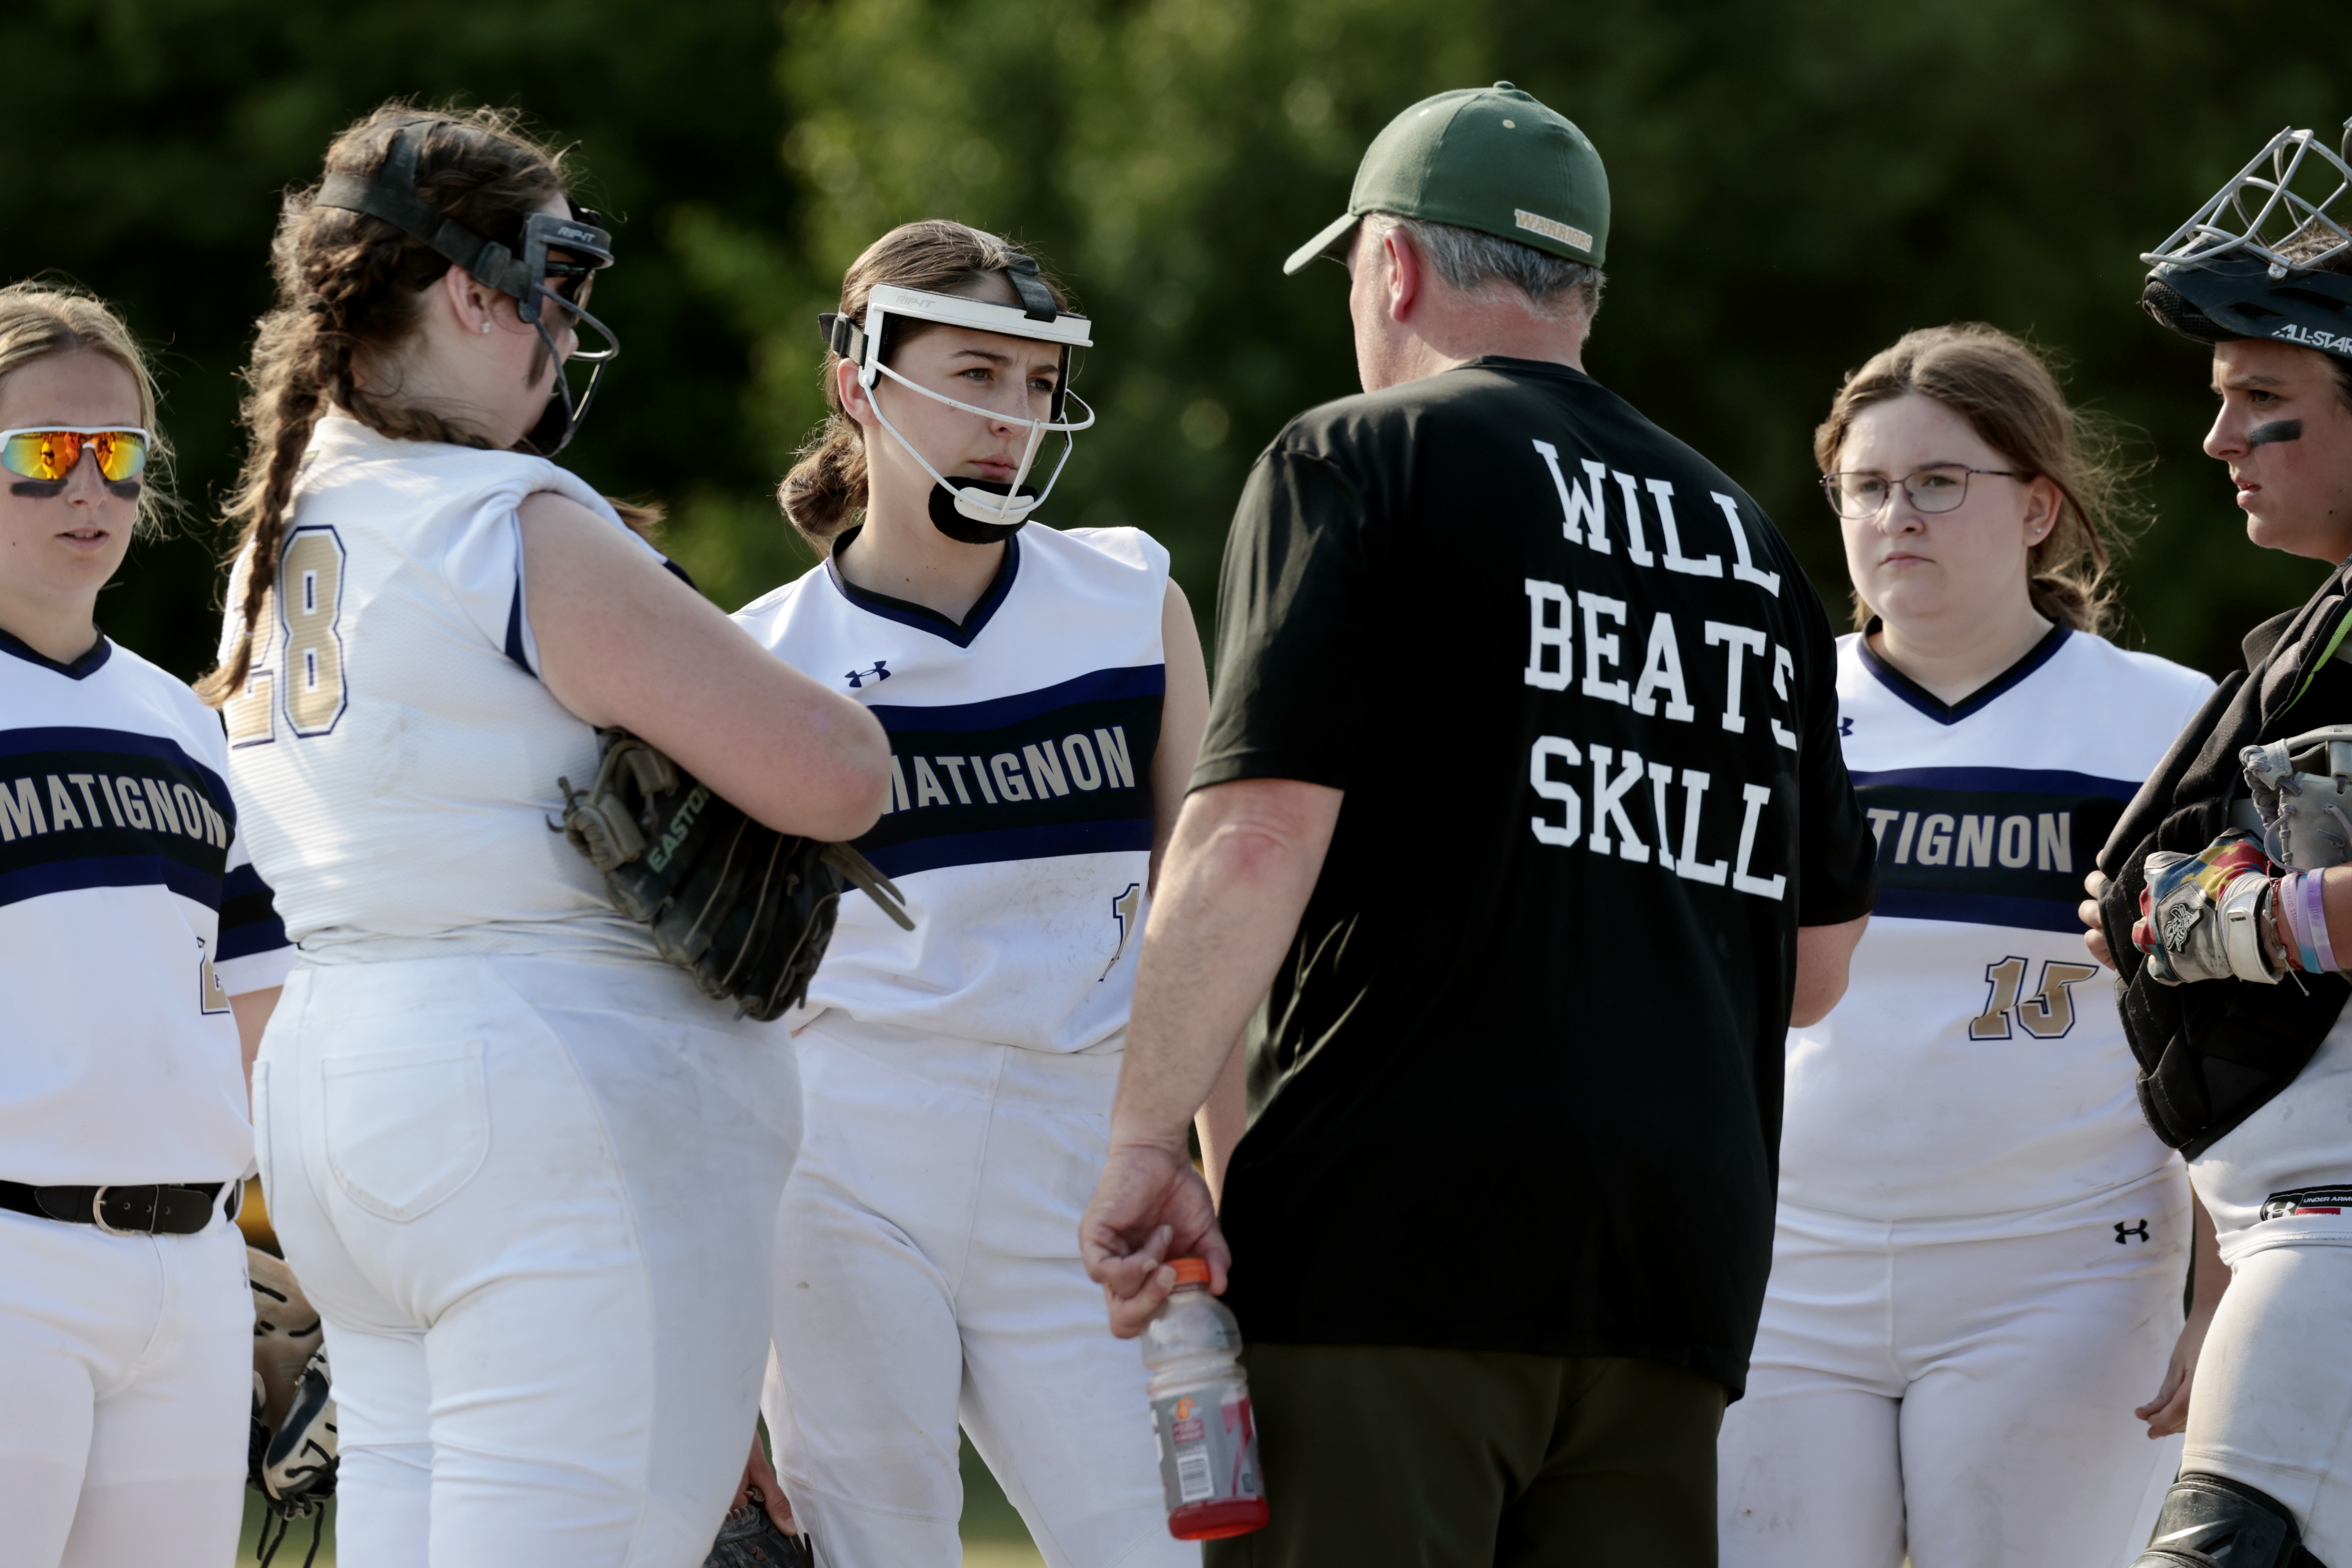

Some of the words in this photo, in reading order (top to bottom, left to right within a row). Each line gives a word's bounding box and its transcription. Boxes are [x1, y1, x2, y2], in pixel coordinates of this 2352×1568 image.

[557, 226, 596, 243] RIP-IT
[1514, 208, 1593, 253] WARRIORS
[895, 295, 936, 308] RIP-IT
[1532, 438, 1781, 598] WILL
[1525, 578, 1797, 751] BEATS
[0, 773, 226, 849] MATIGNON
[1530, 735, 1786, 901] SKILL
[2285, 885, 2294, 908] Breast
[2310, 901, 2321, 927] Faith
[1969, 955, 2099, 1041] 15
